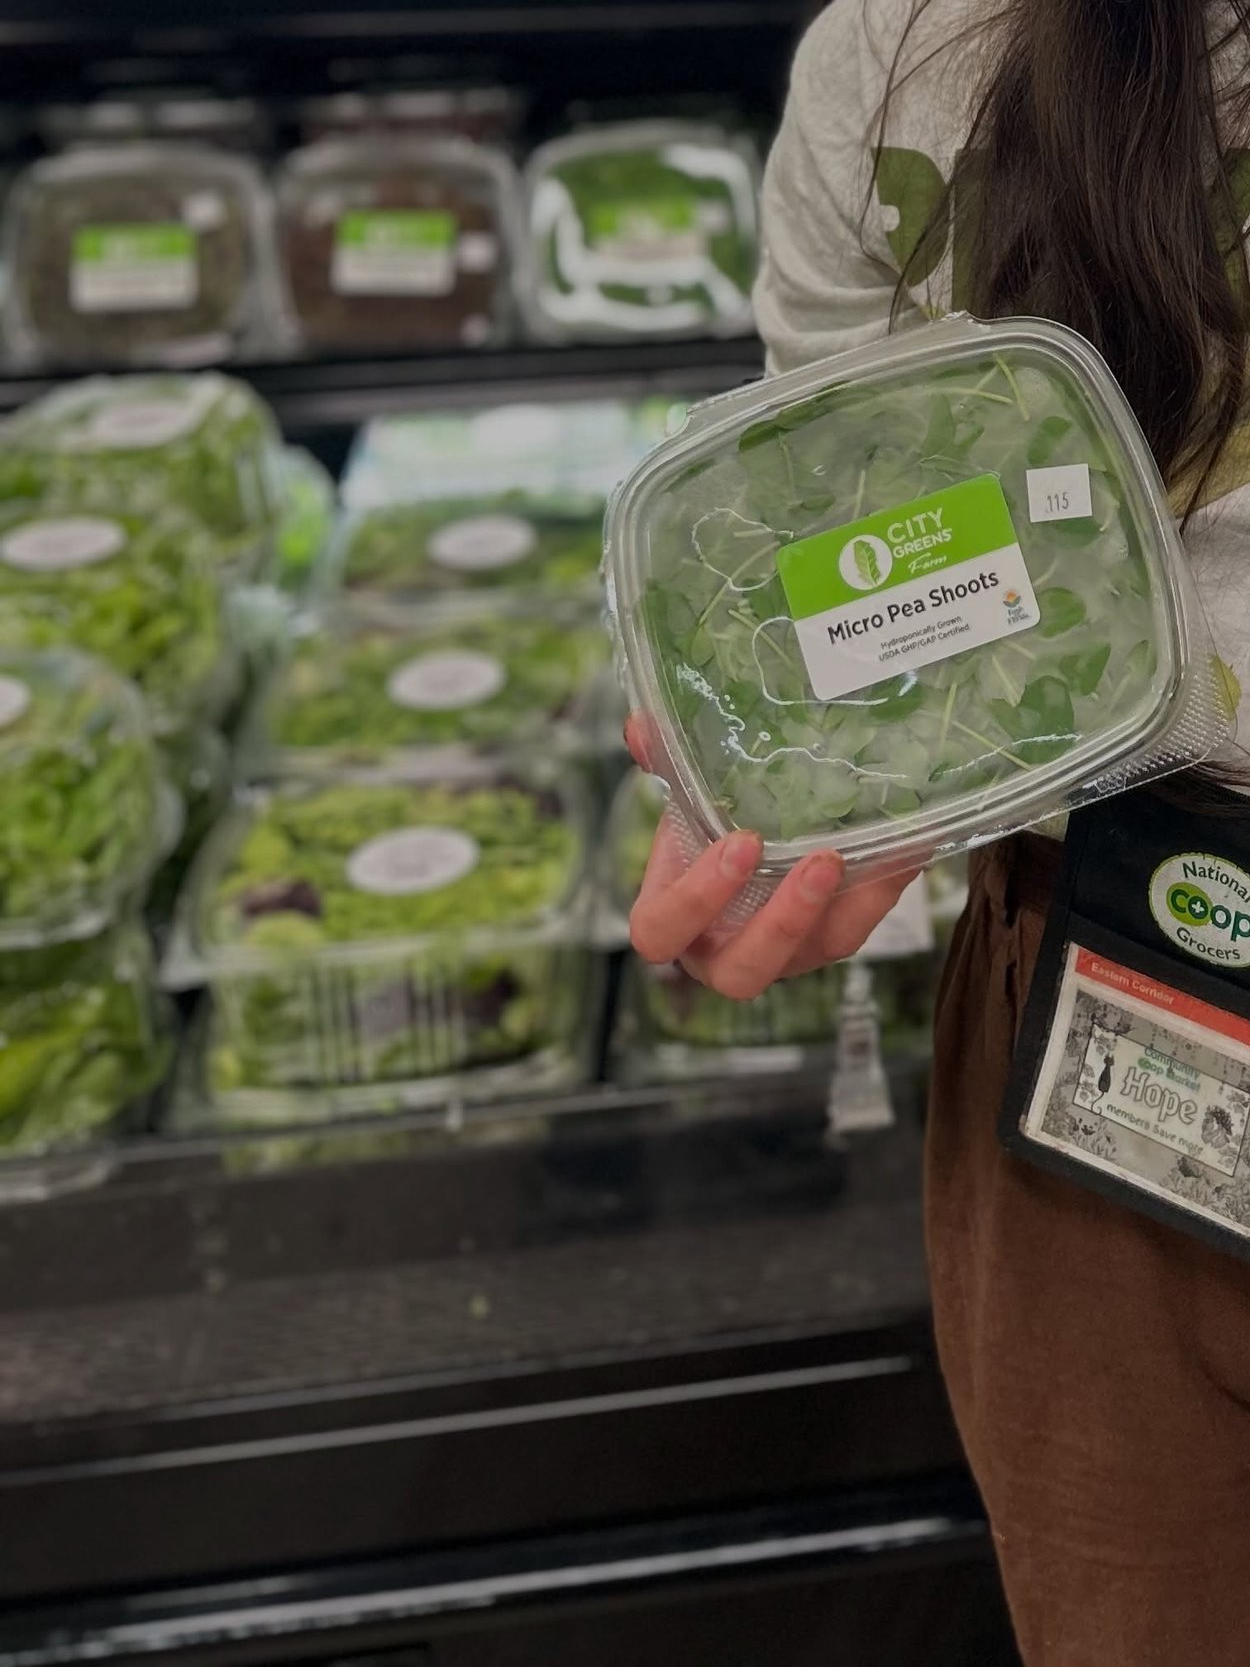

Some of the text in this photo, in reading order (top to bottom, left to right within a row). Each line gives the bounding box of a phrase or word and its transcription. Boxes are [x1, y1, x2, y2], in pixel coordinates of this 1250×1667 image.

[1046, 492, 1069, 512] 115
[887, 507, 943, 543] CITY
[893, 528, 952, 558] GREENS
[908, 552, 947, 574] Farm
[827, 571, 999, 645] Micro Pea Shoots
[879, 623, 970, 662] USDA GHP/GAP Certified
[880, 615, 963, 650] Hydroponically Grown
[1176, 927, 1241, 960] Grocers
[1091, 962, 1175, 1005] Eastern Corridor
[1121, 1066, 1198, 1125] Hope
